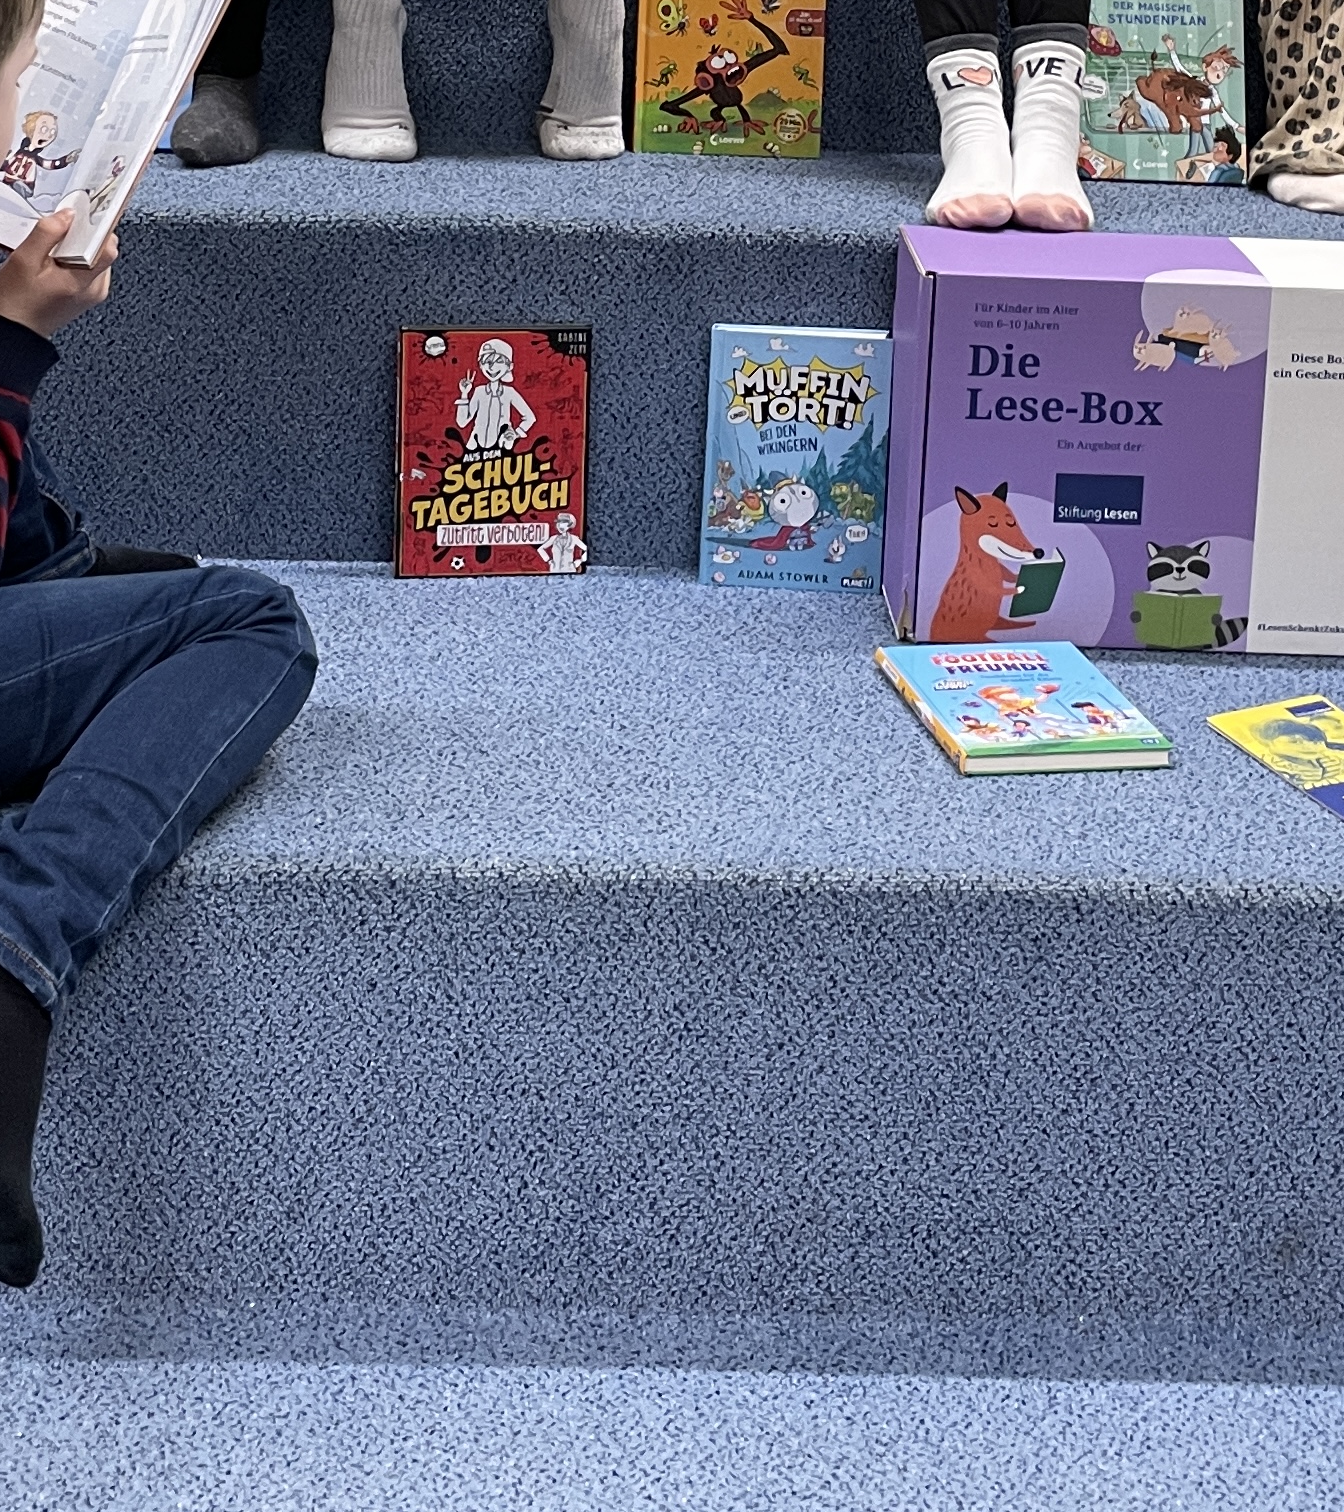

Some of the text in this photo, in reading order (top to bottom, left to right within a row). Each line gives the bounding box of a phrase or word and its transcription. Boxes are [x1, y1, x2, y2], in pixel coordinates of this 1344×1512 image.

[1112, 0, 1193, 14] DER MAGISCHE
[1107, 13, 1207, 26] STUNDENPLAN
[974, 302, 1080, 316] Für Kinder im Alter
[973, 320, 994, 329] von
[1023, 320, 1060, 332] Jahren
[967, 343, 1041, 379] Die
[1290, 353, 1324, 365] Diese
[1273, 368, 1292, 379] ein
[733, 365, 872, 403] MUFFIN
[746, 388, 856, 430] TÖRT!
[964, 387, 1164, 427] Lese-Box
[759, 423, 798, 442] BEI DEN
[757, 437, 818, 456] WIKINGERN
[1057, 439, 1074, 450] Ein
[1076, 440, 1122, 452] Angebot
[462, 449, 502, 464] AUS DEM
[442, 453, 552, 494] SCHUL-
[411, 479, 569, 531] TAGEBUCH
[1058, 505, 1139, 522] Stiftung Lesen
[737, 568, 830, 585] ADAM STOWER
[931, 652, 1050, 666] FOOTBALL
[944, 662, 1054, 675] FREUNDE
